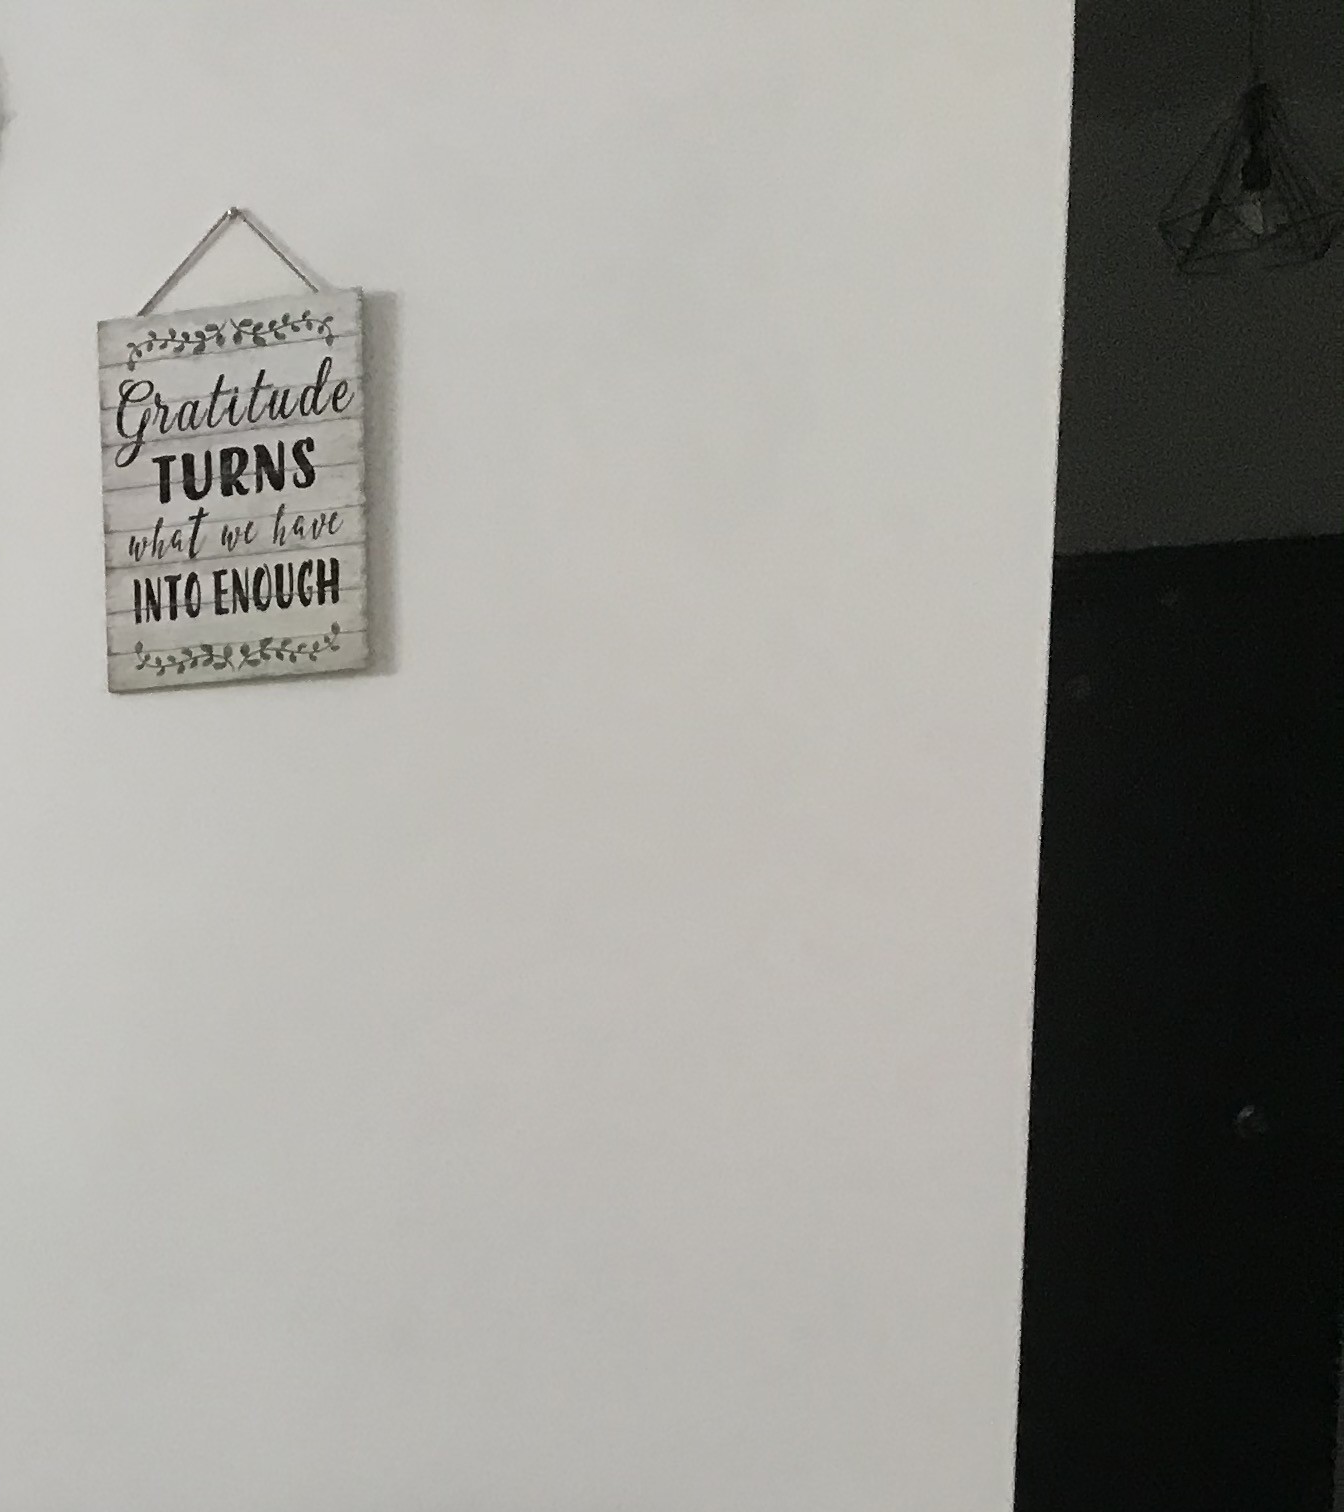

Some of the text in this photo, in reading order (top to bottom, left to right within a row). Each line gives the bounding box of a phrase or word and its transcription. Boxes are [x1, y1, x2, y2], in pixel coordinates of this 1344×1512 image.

[114, 356, 355, 468] Gratitude
[152, 436, 316, 504] TURNS
[128, 503, 344, 562] what we have
[133, 557, 340, 624] INTO ENOUGH
